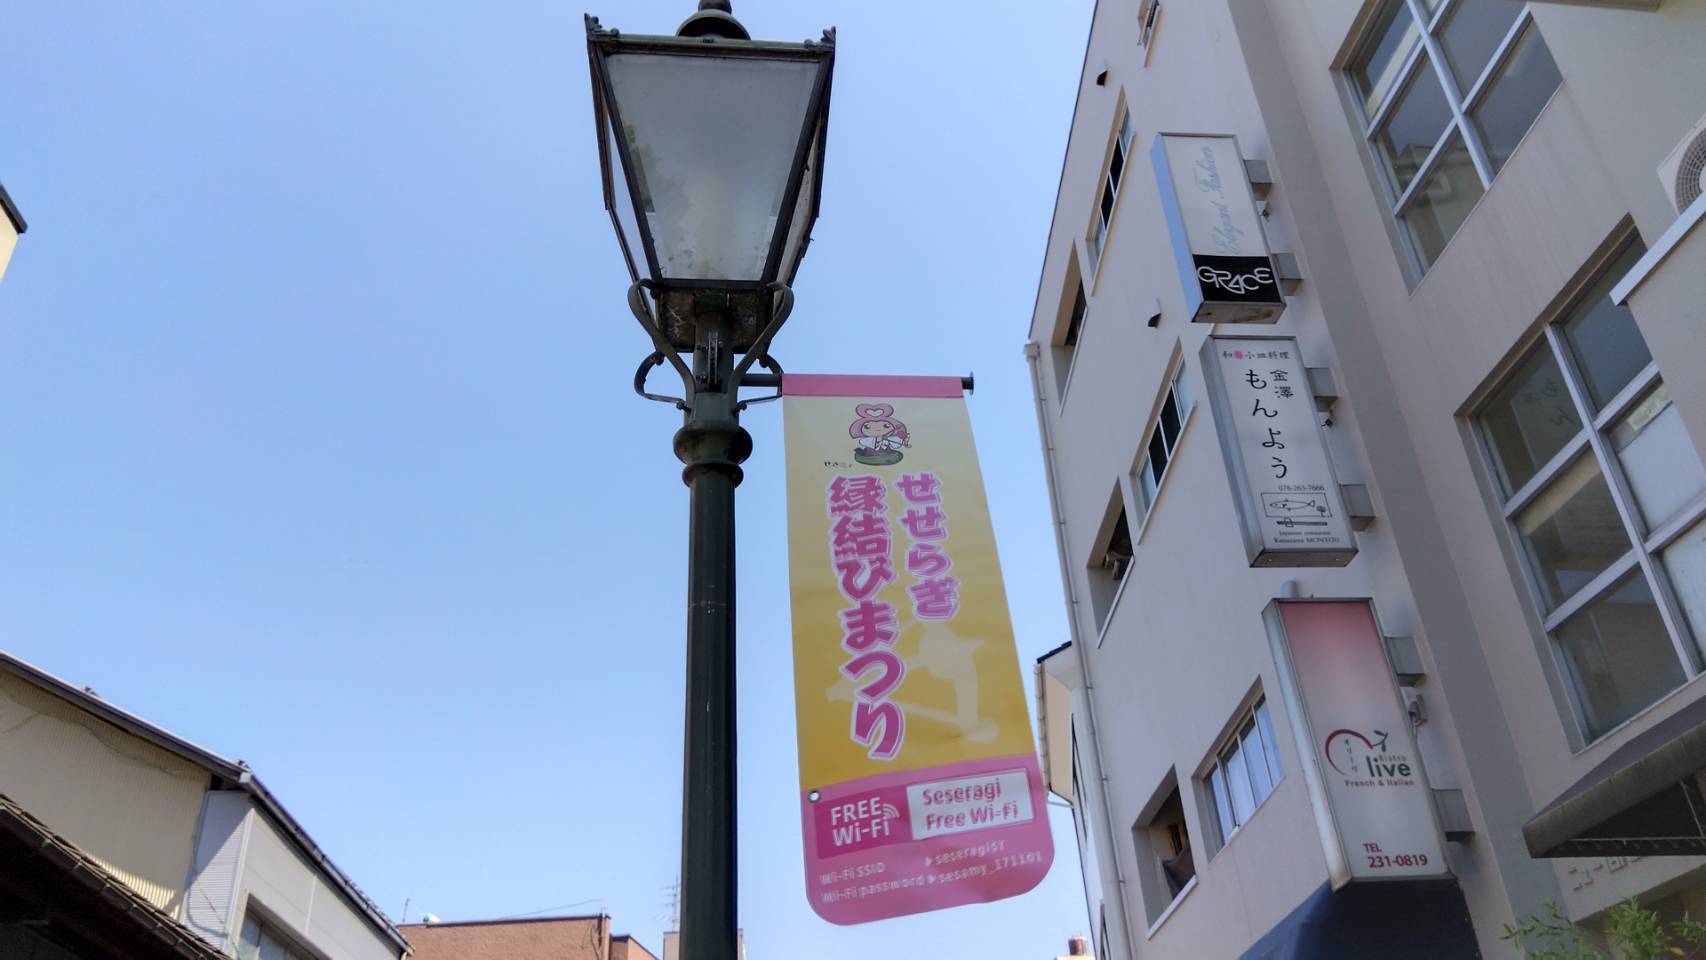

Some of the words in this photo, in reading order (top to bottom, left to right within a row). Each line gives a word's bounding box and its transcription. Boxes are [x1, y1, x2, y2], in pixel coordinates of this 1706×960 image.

[1197, 265, 1274, 294] GRACE
[1270, 368, 1294, 399] 金澤
[1245, 368, 1288, 479] もんよう
[893, 472, 960, 621] せせらぎ
[827, 475, 906, 760] 縁結びまつり
[923, 778, 1002, 806] Seseragi
[1345, 779, 1375, 787] French
[831, 797, 880, 825] FREE
[926, 812, 966, 831] Free
[969, 800, 1018, 825] Wi-Fi
[832, 819, 890, 847] Wi-Fi
[820, 866, 855, 885] Wi-Fi
[856, 862, 886, 878] SSID
[1367, 854, 1428, 868] 231-0819
[820, 886, 857, 903] Wi-Fi
[859, 875, 925, 899] password
